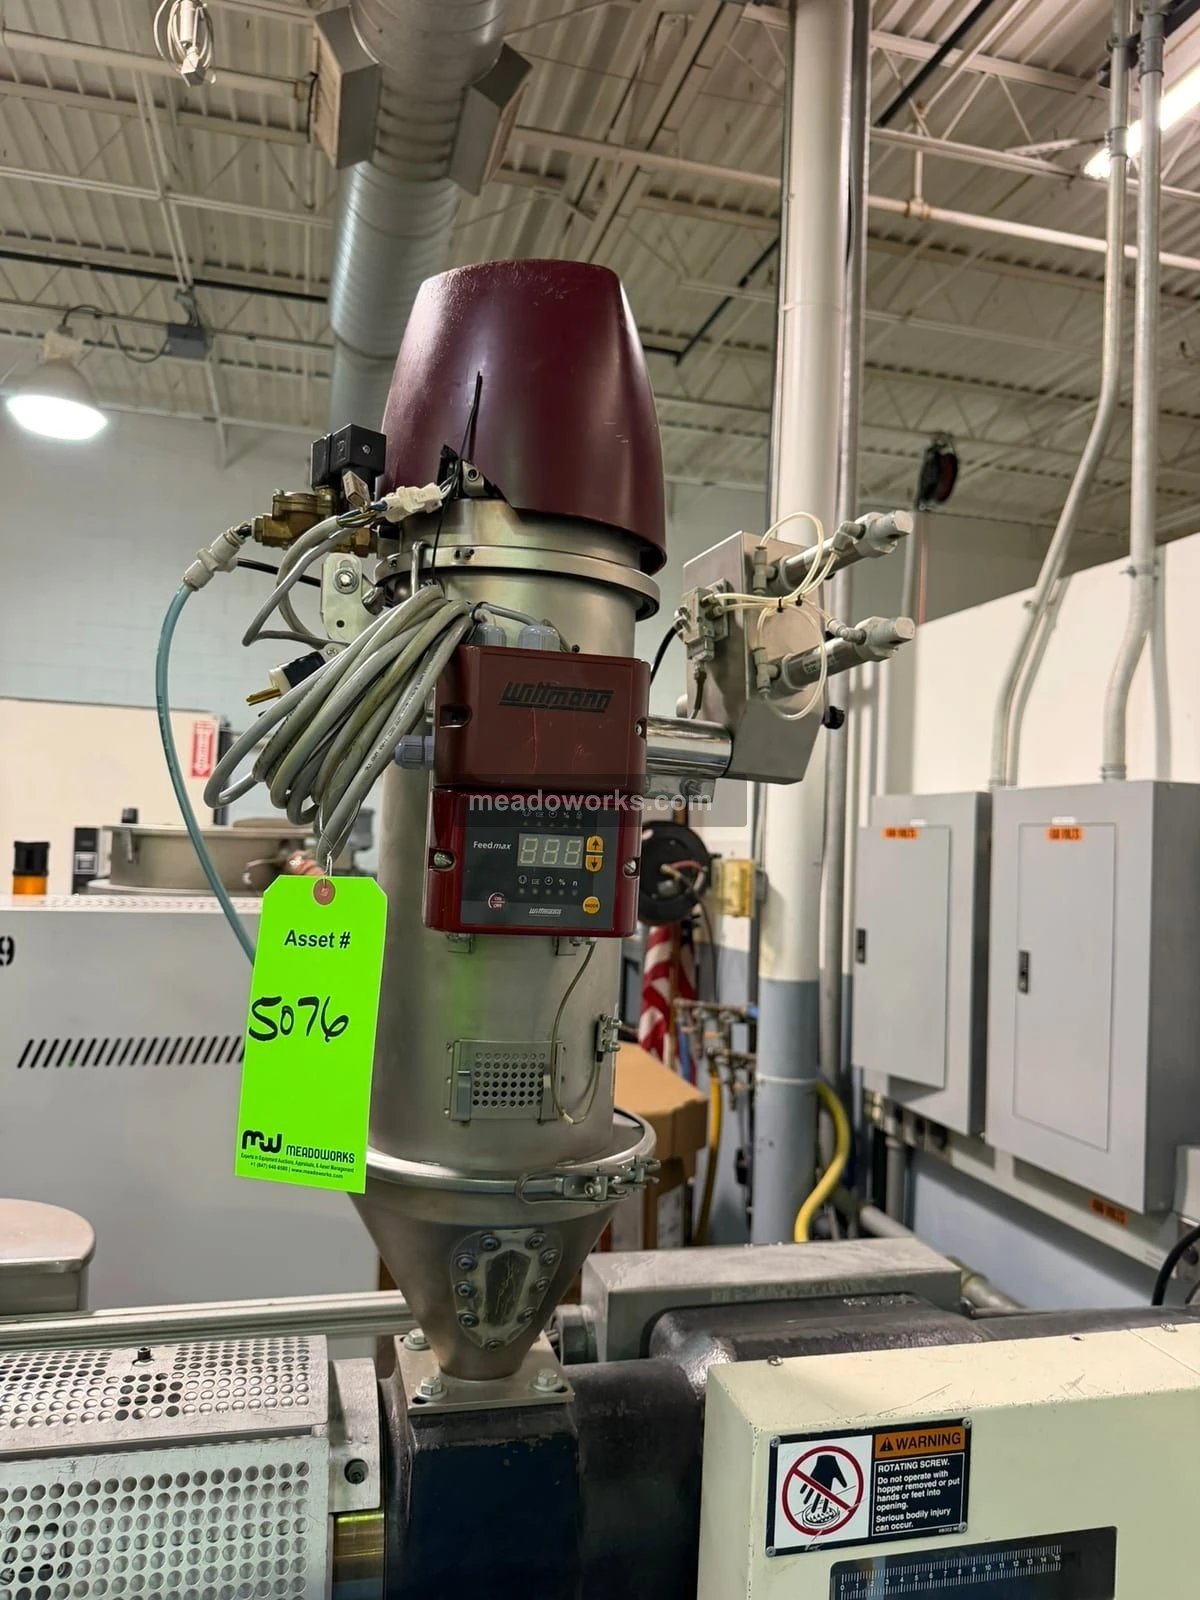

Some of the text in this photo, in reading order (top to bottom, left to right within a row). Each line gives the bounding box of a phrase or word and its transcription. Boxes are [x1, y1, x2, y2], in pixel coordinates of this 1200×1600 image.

[473, 841, 512, 850] Feedmax
[284, 929, 351, 949] Asset #
[286, 1145, 355, 1163] MEADOWORKS
[896, 1432, 961, 1450] WARNING
[878, 1458, 950, 1473] ROTATING SCREW.
[877, 1470, 949, 1485] Do not operate with
[877, 1484, 903, 1494] hopper
[905, 1480, 937, 1490] removed
[948, 1478, 960, 1487] put
[877, 1493, 900, 1502] hands
[911, 1490, 925, 1498] feet
[926, 1488, 941, 1496] into
[876, 1502, 908, 1512] opening.
[875, 1507, 951, 1523] Serious bodily injury
[890, 1521, 914, 1530] occur.
